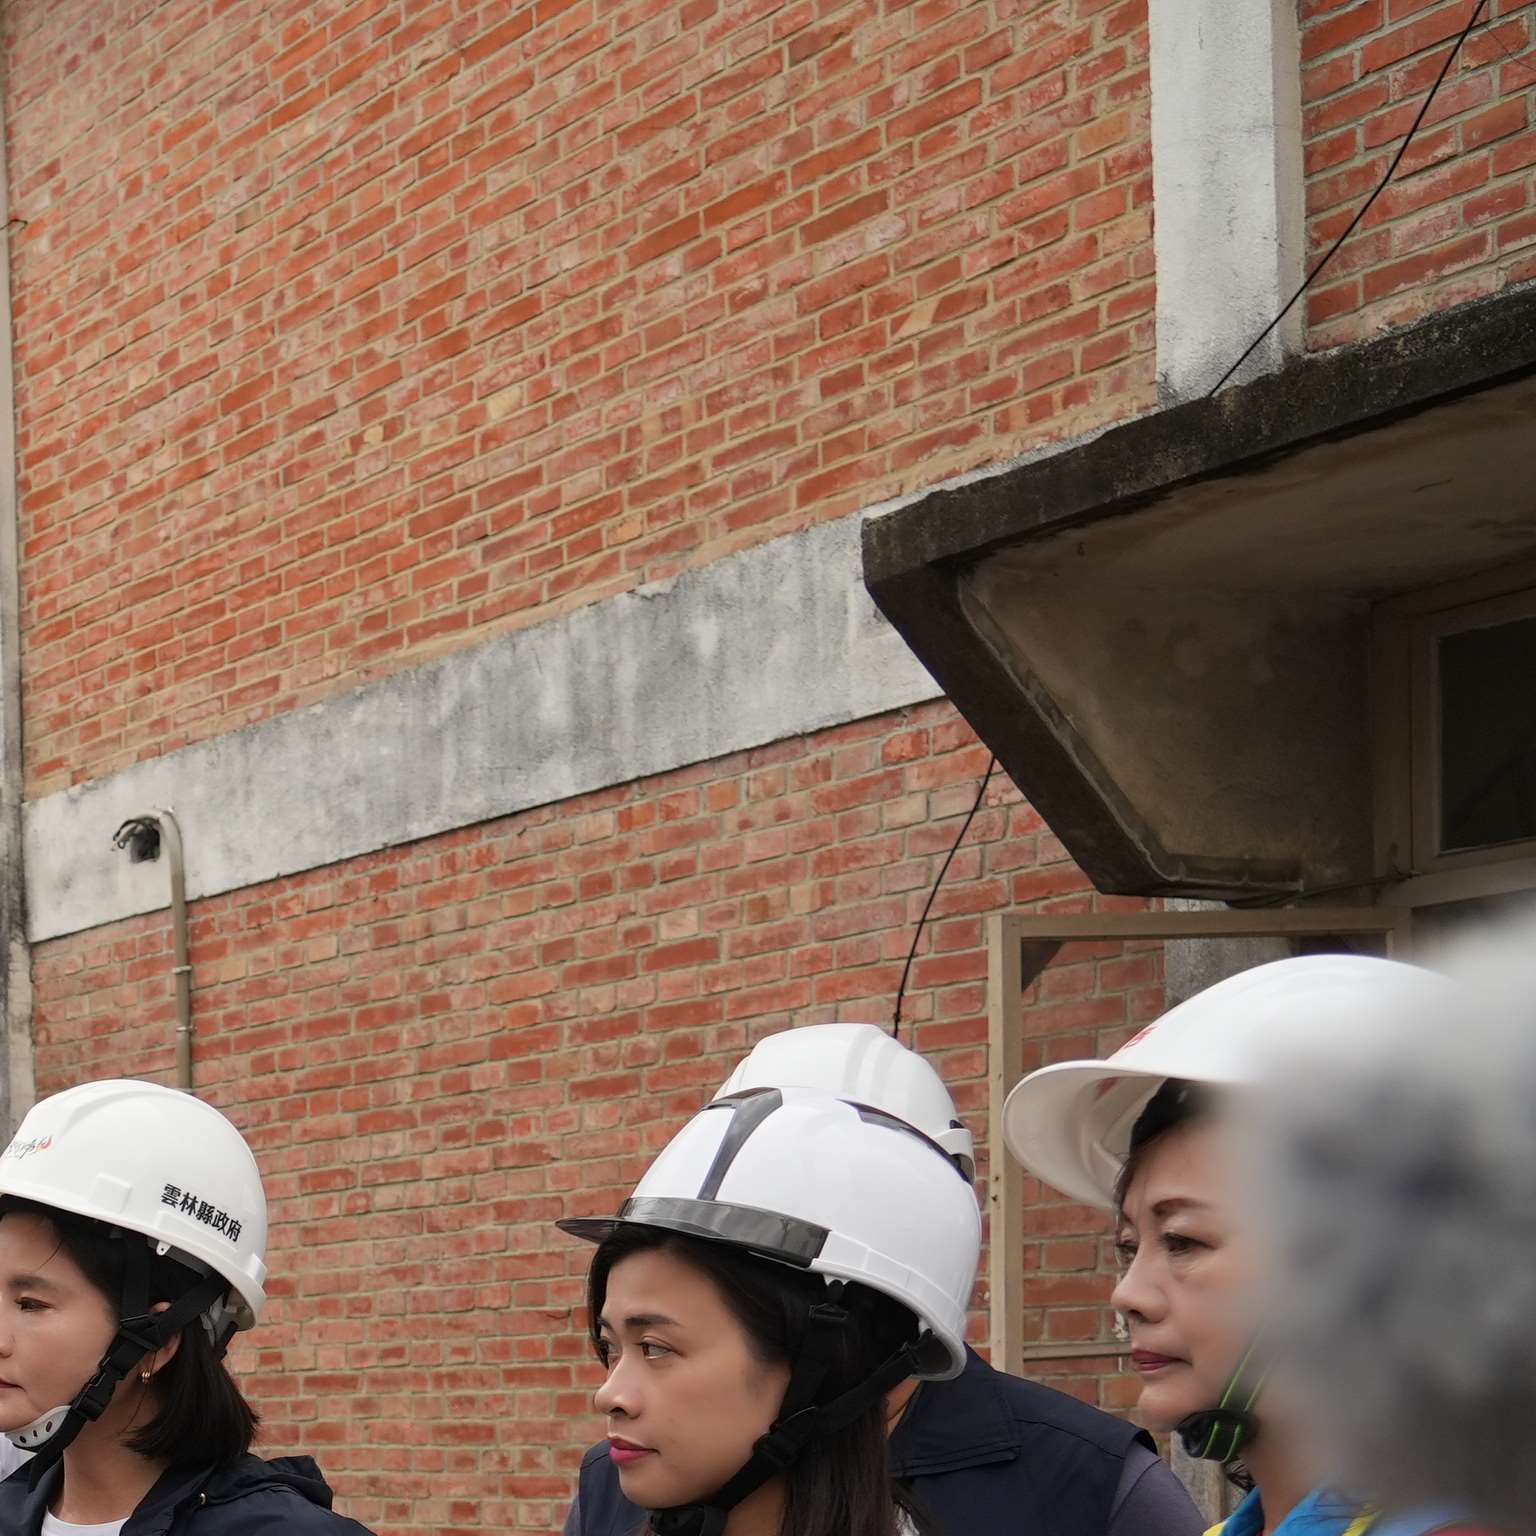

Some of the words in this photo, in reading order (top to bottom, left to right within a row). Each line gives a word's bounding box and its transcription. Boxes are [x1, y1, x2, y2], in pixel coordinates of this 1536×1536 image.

[160, 1183, 243, 1243] 雲林縣政府
